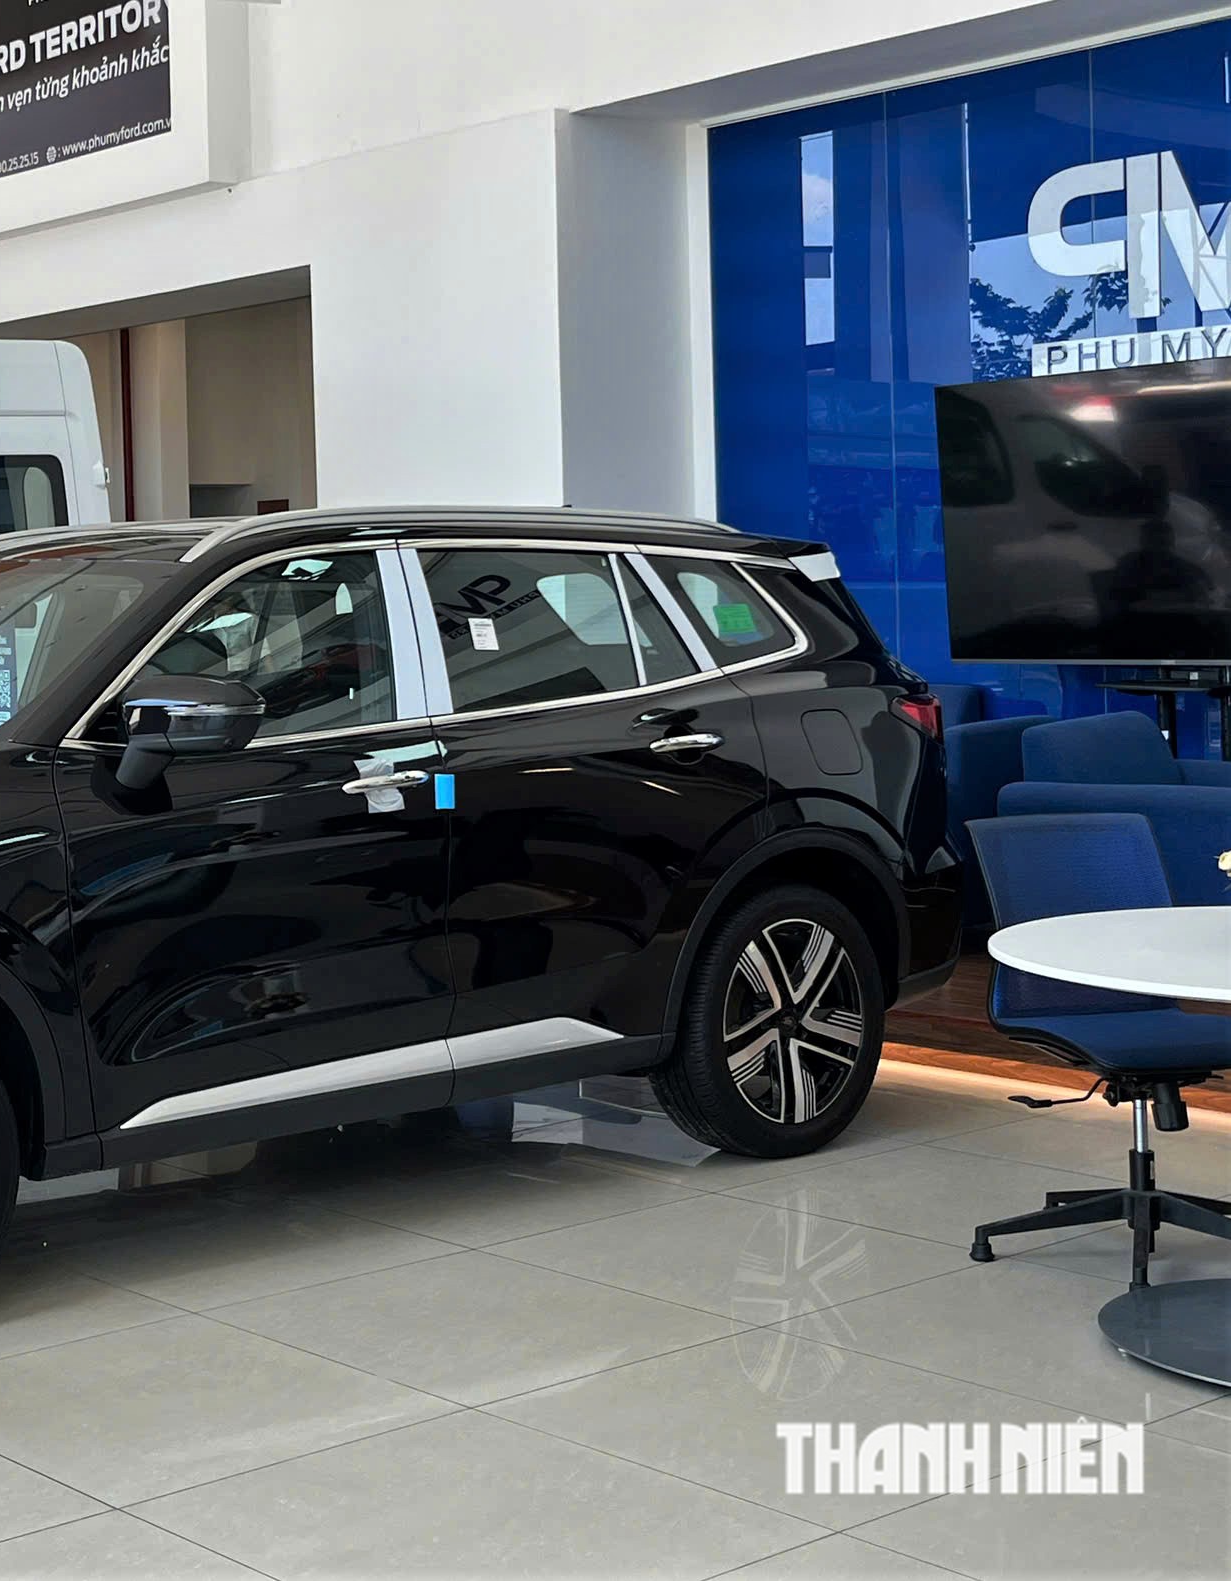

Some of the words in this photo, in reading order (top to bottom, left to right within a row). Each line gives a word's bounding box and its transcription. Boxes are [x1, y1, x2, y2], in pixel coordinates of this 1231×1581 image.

[28, 0, 169, 63] TERRITOR
[7, 87, 33, 112] vẹn
[35, 75, 70, 101] từng
[71, 55, 128, 90] khoảnh
[131, 34, 169, 72] khắc
[1047, 336, 1136, 375] PHU
[1161, 327, 1228, 365] MY
